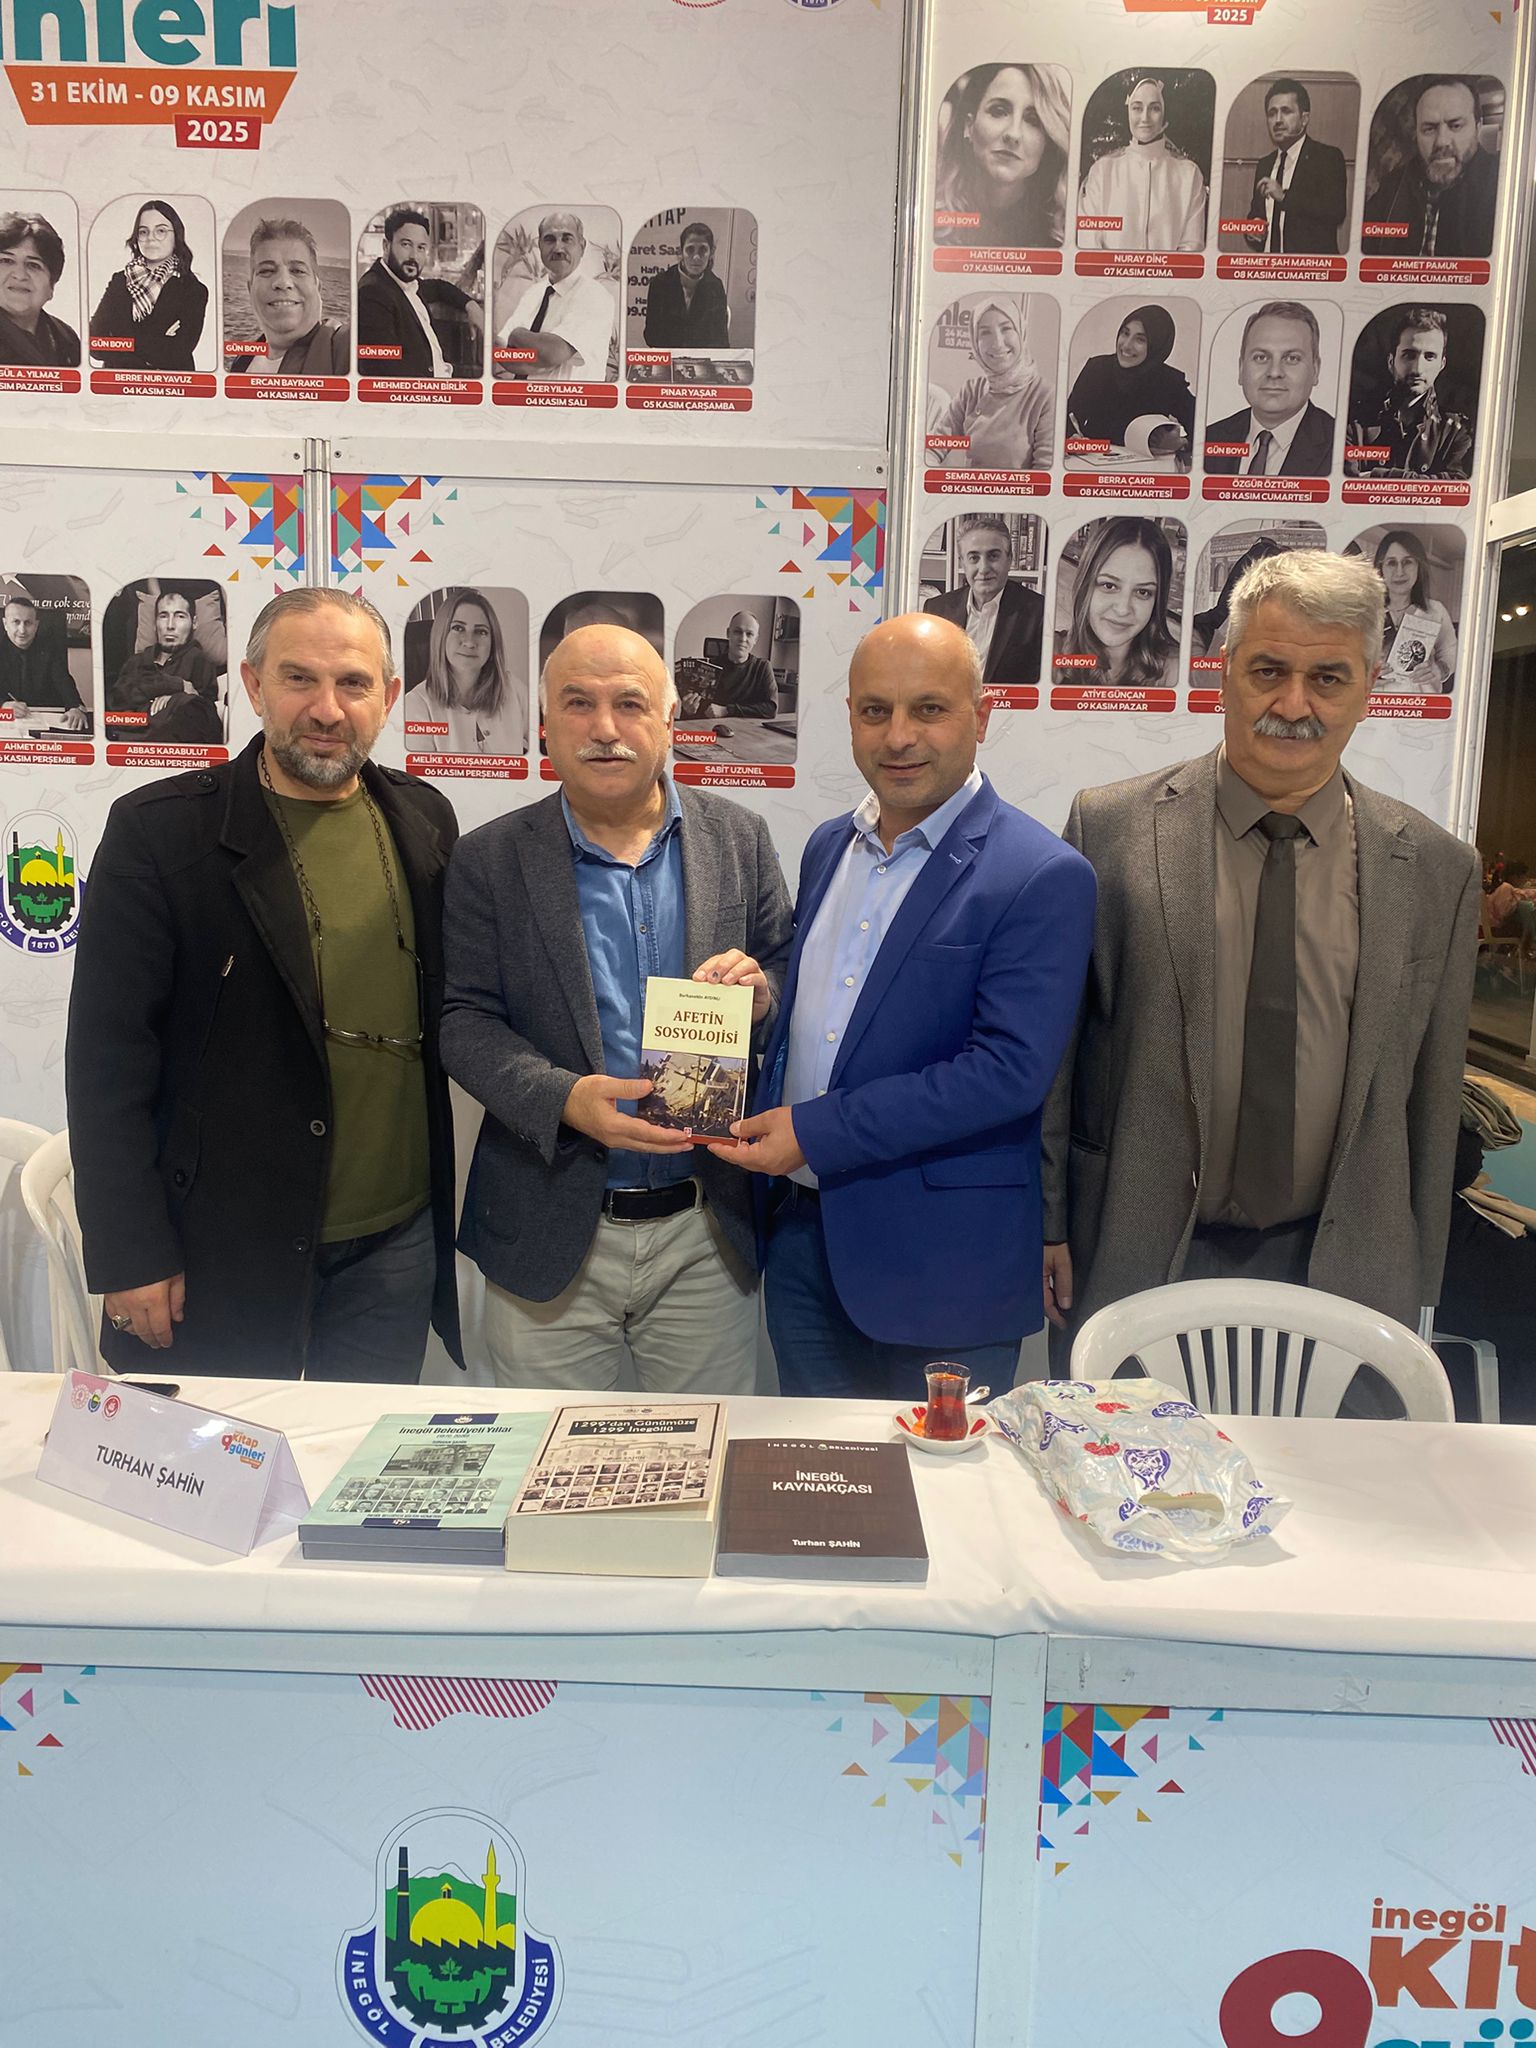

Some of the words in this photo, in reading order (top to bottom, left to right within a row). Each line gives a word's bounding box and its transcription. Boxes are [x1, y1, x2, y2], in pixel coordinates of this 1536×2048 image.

[1213, 8, 1247, 22] 2025
[31, 81, 56, 102] 31
[67, 78, 128, 104] EKİM
[150, 85, 179, 106] 09
[187, 85, 266, 108] KASIM
[187, 119, 249, 143] 2025
[1079, 219, 1098, 229] GÜN
[1099, 220, 1121, 229] BOYU
[1222, 222, 1241, 231] GÜN
[1242, 223, 1264, 232] BOYU
[1365, 225, 1384, 235] GÜN
[1385, 226, 1407, 236] BOYU
[970, 249, 1001, 260] HATİCE
[1002, 251, 1027, 261] USLU
[1114, 254, 1145, 263] NURAY
[1146, 254, 1168, 266] DİNÇ
[1230, 257, 1269, 267] MEHMET
[1271, 258, 1290, 268] ŞAH
[1291, 259, 1331, 268] MARHAN
[1392, 260, 1422, 270] AHMET
[1423, 261, 1458, 270] PAMUK
[963, 264, 974, 272] 07
[974, 264, 1004, 273] KASIM
[1005, 265, 1032, 274] CUMA
[1104, 267, 1115, 276] 07
[1116, 268, 1145, 277] KASIM
[1145, 268, 1173, 278] CUMA
[1234, 270, 1246, 280] 08
[1247, 271, 1275, 280] KASIM
[1275, 270, 1329, 281] CUMARTESİ
[1377, 273, 1389, 282] 08
[1389, 273, 1418, 283] KASIM
[1418, 273, 1472, 284] CUMARTESİ
[91, 338, 107, 349] GÜN
[107, 340, 132, 350] BOYU
[226, 343, 241, 352] GÜN
[242, 344, 266, 354] BOYU
[359, 348, 374, 357] GÜN
[375, 348, 400, 357] BOYU
[494, 350, 509, 360] GÜN
[510, 352, 535, 360] BOYU
[628, 353, 643, 362] GÜN
[644, 355, 669, 363] BOYU
[27, 371, 60, 379] YILMAZ
[115, 373, 143, 383] BERRE
[143, 374, 163, 383] NUR
[163, 374, 192, 385] YAVUZ
[16, 383, 63, 391] PAZARTESİ
[250, 378, 279, 387] ERCAN
[280, 379, 324, 388] BAYRAKCI
[373, 380, 412, 391] MEHMED
[413, 379, 437, 391] CİHAN
[438, 380, 467, 392] BİRLİK
[526, 382, 548, 394] ÖZER
[549, 385, 584, 395] YILMAZ
[122, 386, 135, 395] 04
[135, 387, 164, 396] KASIM
[165, 388, 185, 397] SALI
[256, 390, 269, 399] 04
[269, 390, 298, 400] KASIM
[299, 391, 318, 400] SALI
[661, 388, 687, 397] PINAR
[687, 388, 718, 400] YAŞAR
[390, 394, 402, 403] 04
[402, 394, 431, 403] KASIM
[432, 395, 452, 404] SALI
[525, 397, 538, 407] 04
[539, 398, 566, 407] KASIM
[567, 398, 588, 408] SALI
[643, 400, 656, 410] 05
[656, 400, 684, 410] KASIM
[685, 401, 735, 412] ÇARŞAMBA
[928, 438, 946, 447] GÜN
[946, 438, 969, 448] BOYU
[1067, 441, 1085, 451] GÜN
[1086, 442, 1109, 451] BOYU
[1207, 446, 1226, 455] GÜN
[1226, 446, 1248, 455] BOYU
[1348, 448, 1366, 458] GÜN
[1367, 449, 1389, 458] BOYU
[945, 471, 976, 481] SEMRA
[977, 472, 1005, 481] ARVAS
[1006, 472, 1031, 483] ATEŞ
[1099, 475, 1128, 484] BERRA
[1129, 476, 1155, 487] ÇAKIR
[941, 485, 953, 494] 08
[953, 485, 982, 494] KASIM
[983, 484, 1034, 495] CUMARTESİ
[1232, 478, 1262, 489] ÖZGÜR
[1263, 479, 1300, 490] ÖZTÜRK
[1344, 483, 1398, 492] MUHAMMED
[1400, 483, 1431, 493] UBEYD
[1432, 483, 1469, 494] AYTEKİN
[1080, 488, 1091, 496] 08
[1091, 488, 1121, 497] KASIM
[1122, 488, 1173, 499] CUMARTESİ
[1219, 492, 1230, 500] 08
[1231, 492, 1261, 501] KASIM
[1261, 492, 1312, 502] CUMARTESİ
[1369, 495, 1381, 504] 09
[1381, 495, 1410, 505] KASIM
[1410, 496, 1441, 505] PAZAR
[1055, 657, 1076, 666] GÜN
[1076, 658, 1096, 667] BOYU
[1082, 688, 1105, 698] ATİYE
[1106, 689, 1146, 701] GÜNÇAN
[1077, 702, 1089, 711] 09
[1089, 702, 1118, 711] KASIM
[1119, 703, 1148, 711] PAZAR
[1383, 696, 1427, 706] KARAGÖZ
[106, 715, 124, 723] GÜN
[125, 716, 146, 724] BOYU
[1393, 710, 1423, 718] PAZAR
[407, 724, 425, 733] GÜN
[426, 725, 448, 734] BOYU
[676, 734, 693, 742] GÜN
[693, 734, 716, 743] BOYU
[4, 742, 35, 751] AHMET
[36, 742, 62, 751] DEMİR
[127, 746, 155, 755] ABBAS
[156, 747, 208, 756] KARABULUT
[4, 754, 30, 763] KASIM
[31, 755, 76, 766] PERŞEMBE
[125, 758, 136, 766] 06
[137, 758, 165, 766] KASIM
[166, 759, 210, 769] PERŞEMBE
[412, 755, 443, 765] MELİKE
[445, 757, 521, 768] VURUŞANKAPLAN
[425, 768, 436, 776] 06
[437, 768, 465, 777] KASIM
[466, 769, 510, 779] PERŞEMBE
[705, 764, 729, 774] SABİT
[730, 766, 764, 774] UZUNEL
[701, 777, 712, 785] 07
[712, 777, 740, 786] KASIM
[741, 778, 767, 786] CUMA
[31, 940, 56, 950] 1870
[673, 1010, 724, 1025] AFETİN
[654, 1025, 738, 1045] SOSYOLOJİSİ
[228, 1444, 266, 1462] günleri
[97, 1444, 155, 1479] TURHAN
[156, 1466, 205, 1497] ŞAHİN
[796, 1470, 848, 1483] İNEGÖL
[772, 1481, 873, 1494] KAYNAKÇASI
[792, 1539, 826, 1547] Turhan
[828, 1539, 861, 1549] ŞAHİN
[1371, 1897, 1507, 1938] inegöl
[351, 1949, 390, 2036] İNEGÖL
[488, 1956, 549, 2048] BELEDİYESİ
